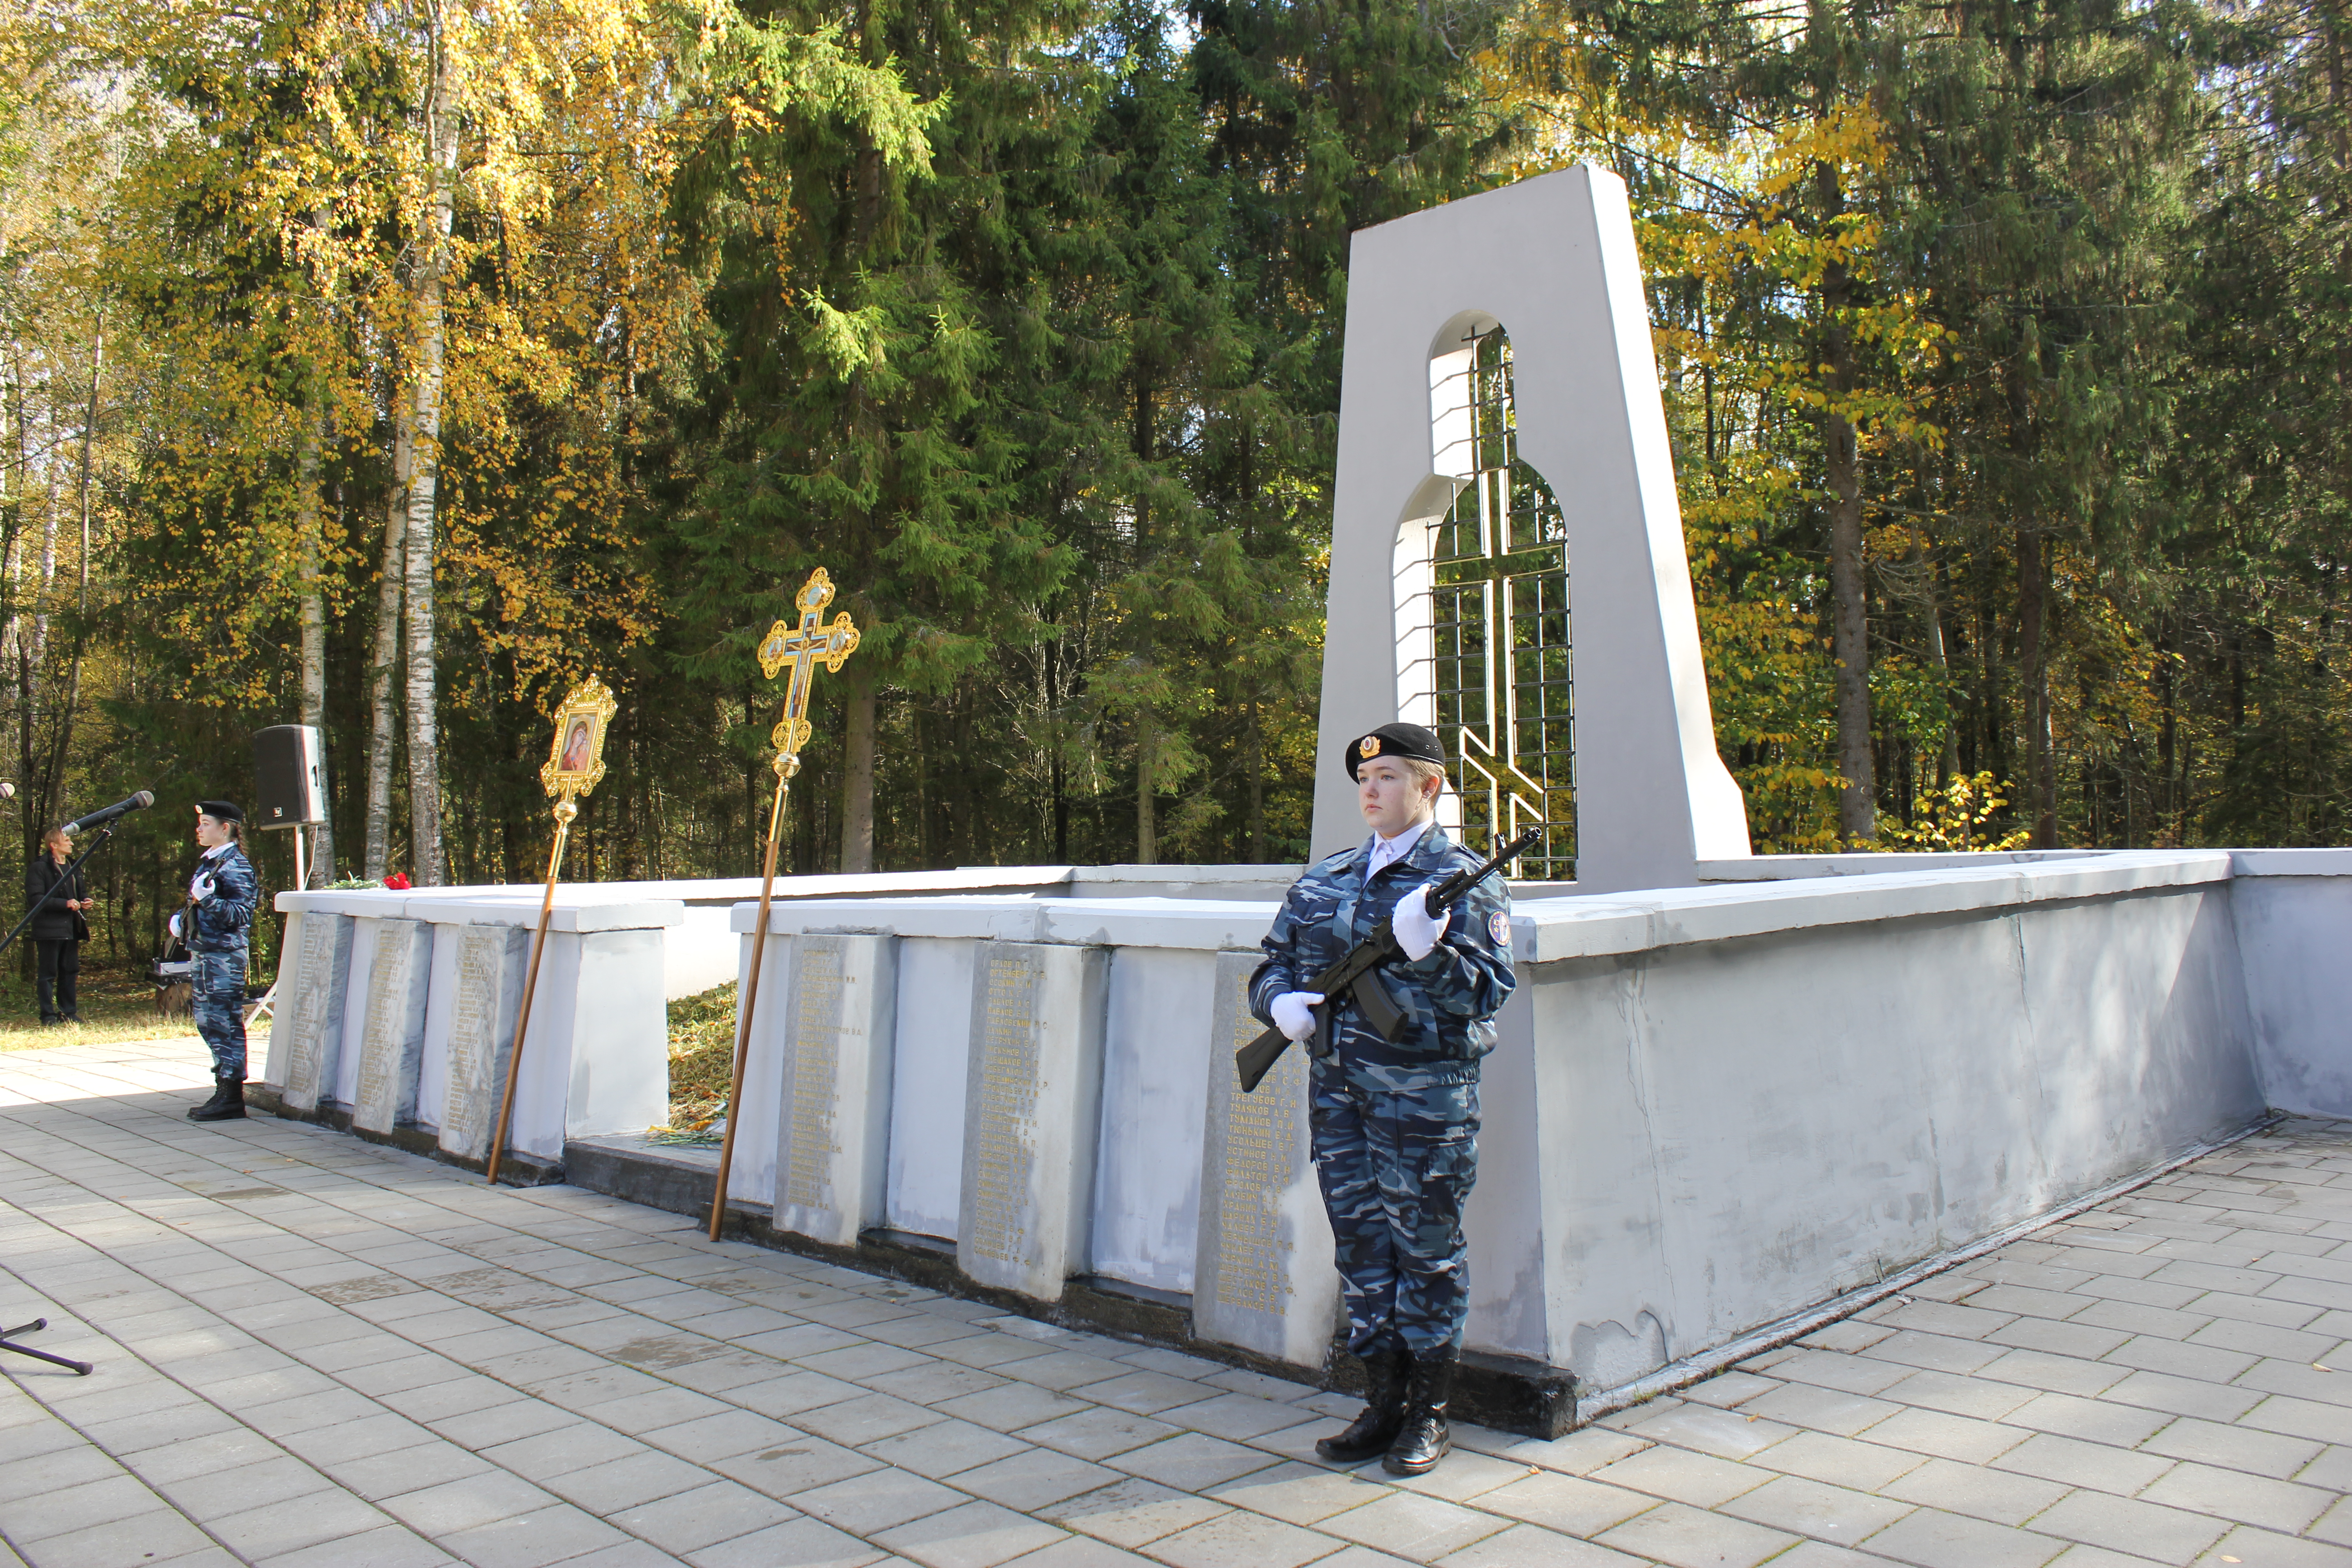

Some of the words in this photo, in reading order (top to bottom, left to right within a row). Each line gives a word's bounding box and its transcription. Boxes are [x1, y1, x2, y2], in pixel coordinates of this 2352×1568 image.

[990, 968, 1029, 979] ОРТЕНБЕРГ
[989, 987, 1005, 996] ОТТО
[1230, 1092, 1275, 1106] ТРЕГУБОВ
[1280, 1098, 1300, 1109] Г.Н.
[1230, 1102, 1269, 1116] ТУЛЯКОВ
[1229, 1113, 1271, 1127] ТУМАНОВ
[1229, 1123, 1270, 1138] ТЮНЬКИН
[1227, 1134, 1272, 1149] УСОЛЬЦЕВ
[1226, 1145, 1266, 1160] УСТИНОВ
[1226, 1156, 1268, 1171] ФЕДОРОВ
[1225, 1167, 1267, 1182] ФИЛАТОВ
[1225, 1177, 1261, 1192] ФРОЛОВ
[1219, 1262, 1268, 1280] ШЕВЧЕНКО
[1218, 1272, 1266, 1291] ШЕСТАКОВ
